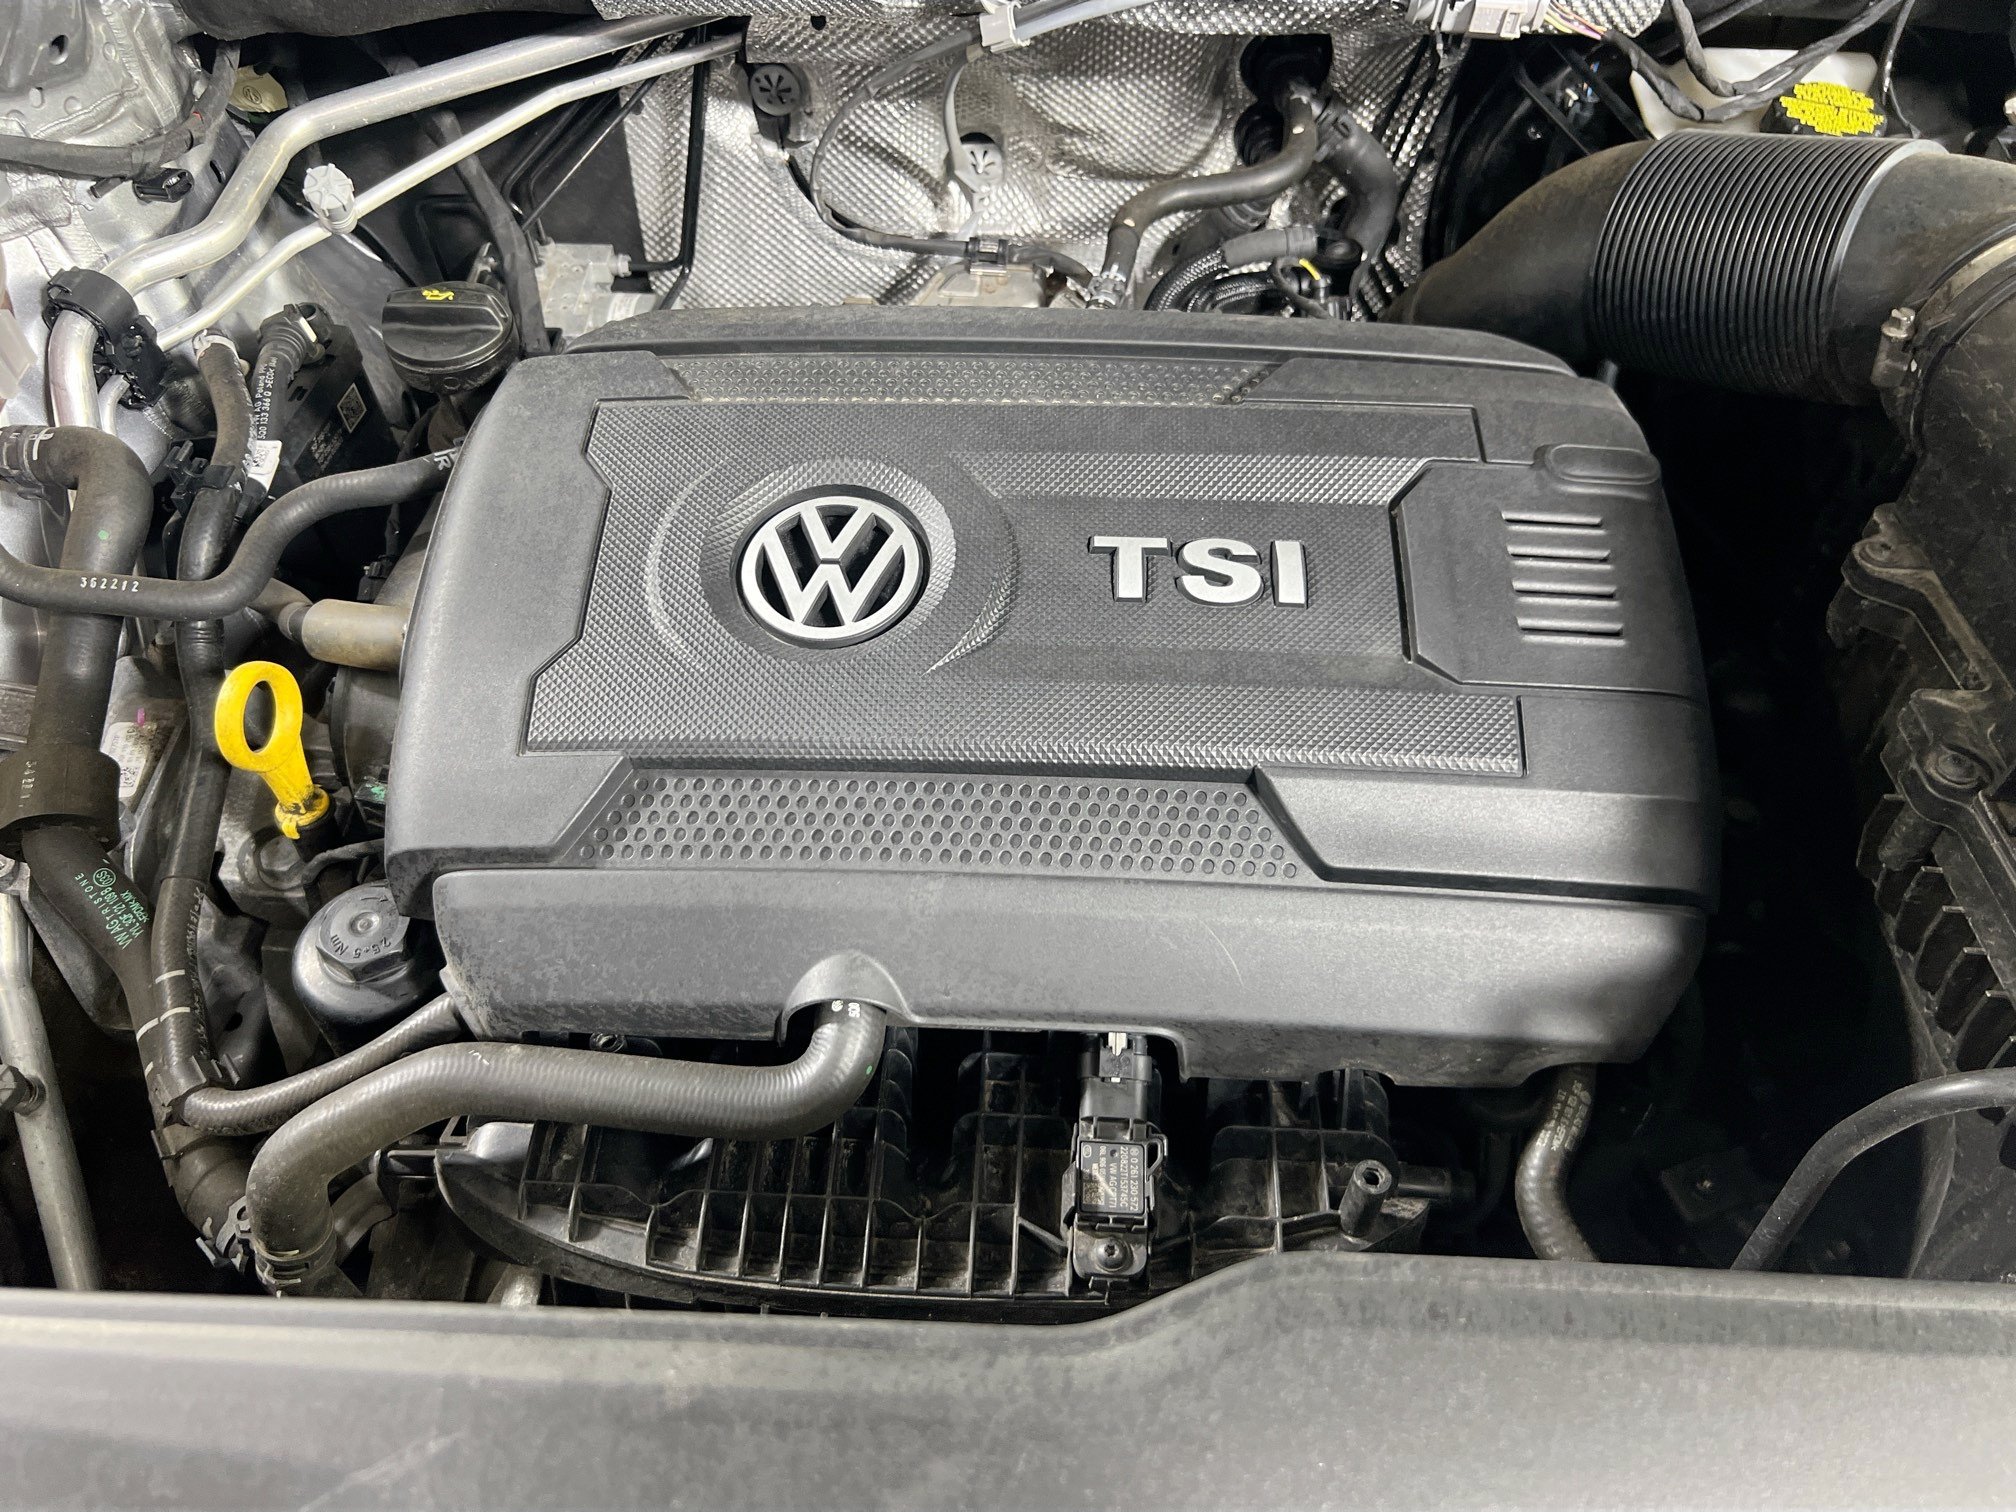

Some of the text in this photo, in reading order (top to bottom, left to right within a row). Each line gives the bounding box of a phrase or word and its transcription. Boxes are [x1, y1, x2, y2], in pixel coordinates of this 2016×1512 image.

[262, 398, 271, 411] 366
[741, 496, 919, 639] VW
[1090, 535, 1307, 606] TSI
[74, 872, 115, 921] TRISTONE
[112, 902, 127, 915] 121
[1130, 1165, 1139, 1178] 261
[1129, 1180, 1139, 1195] 230
[1129, 1196, 1139, 1211] 572
